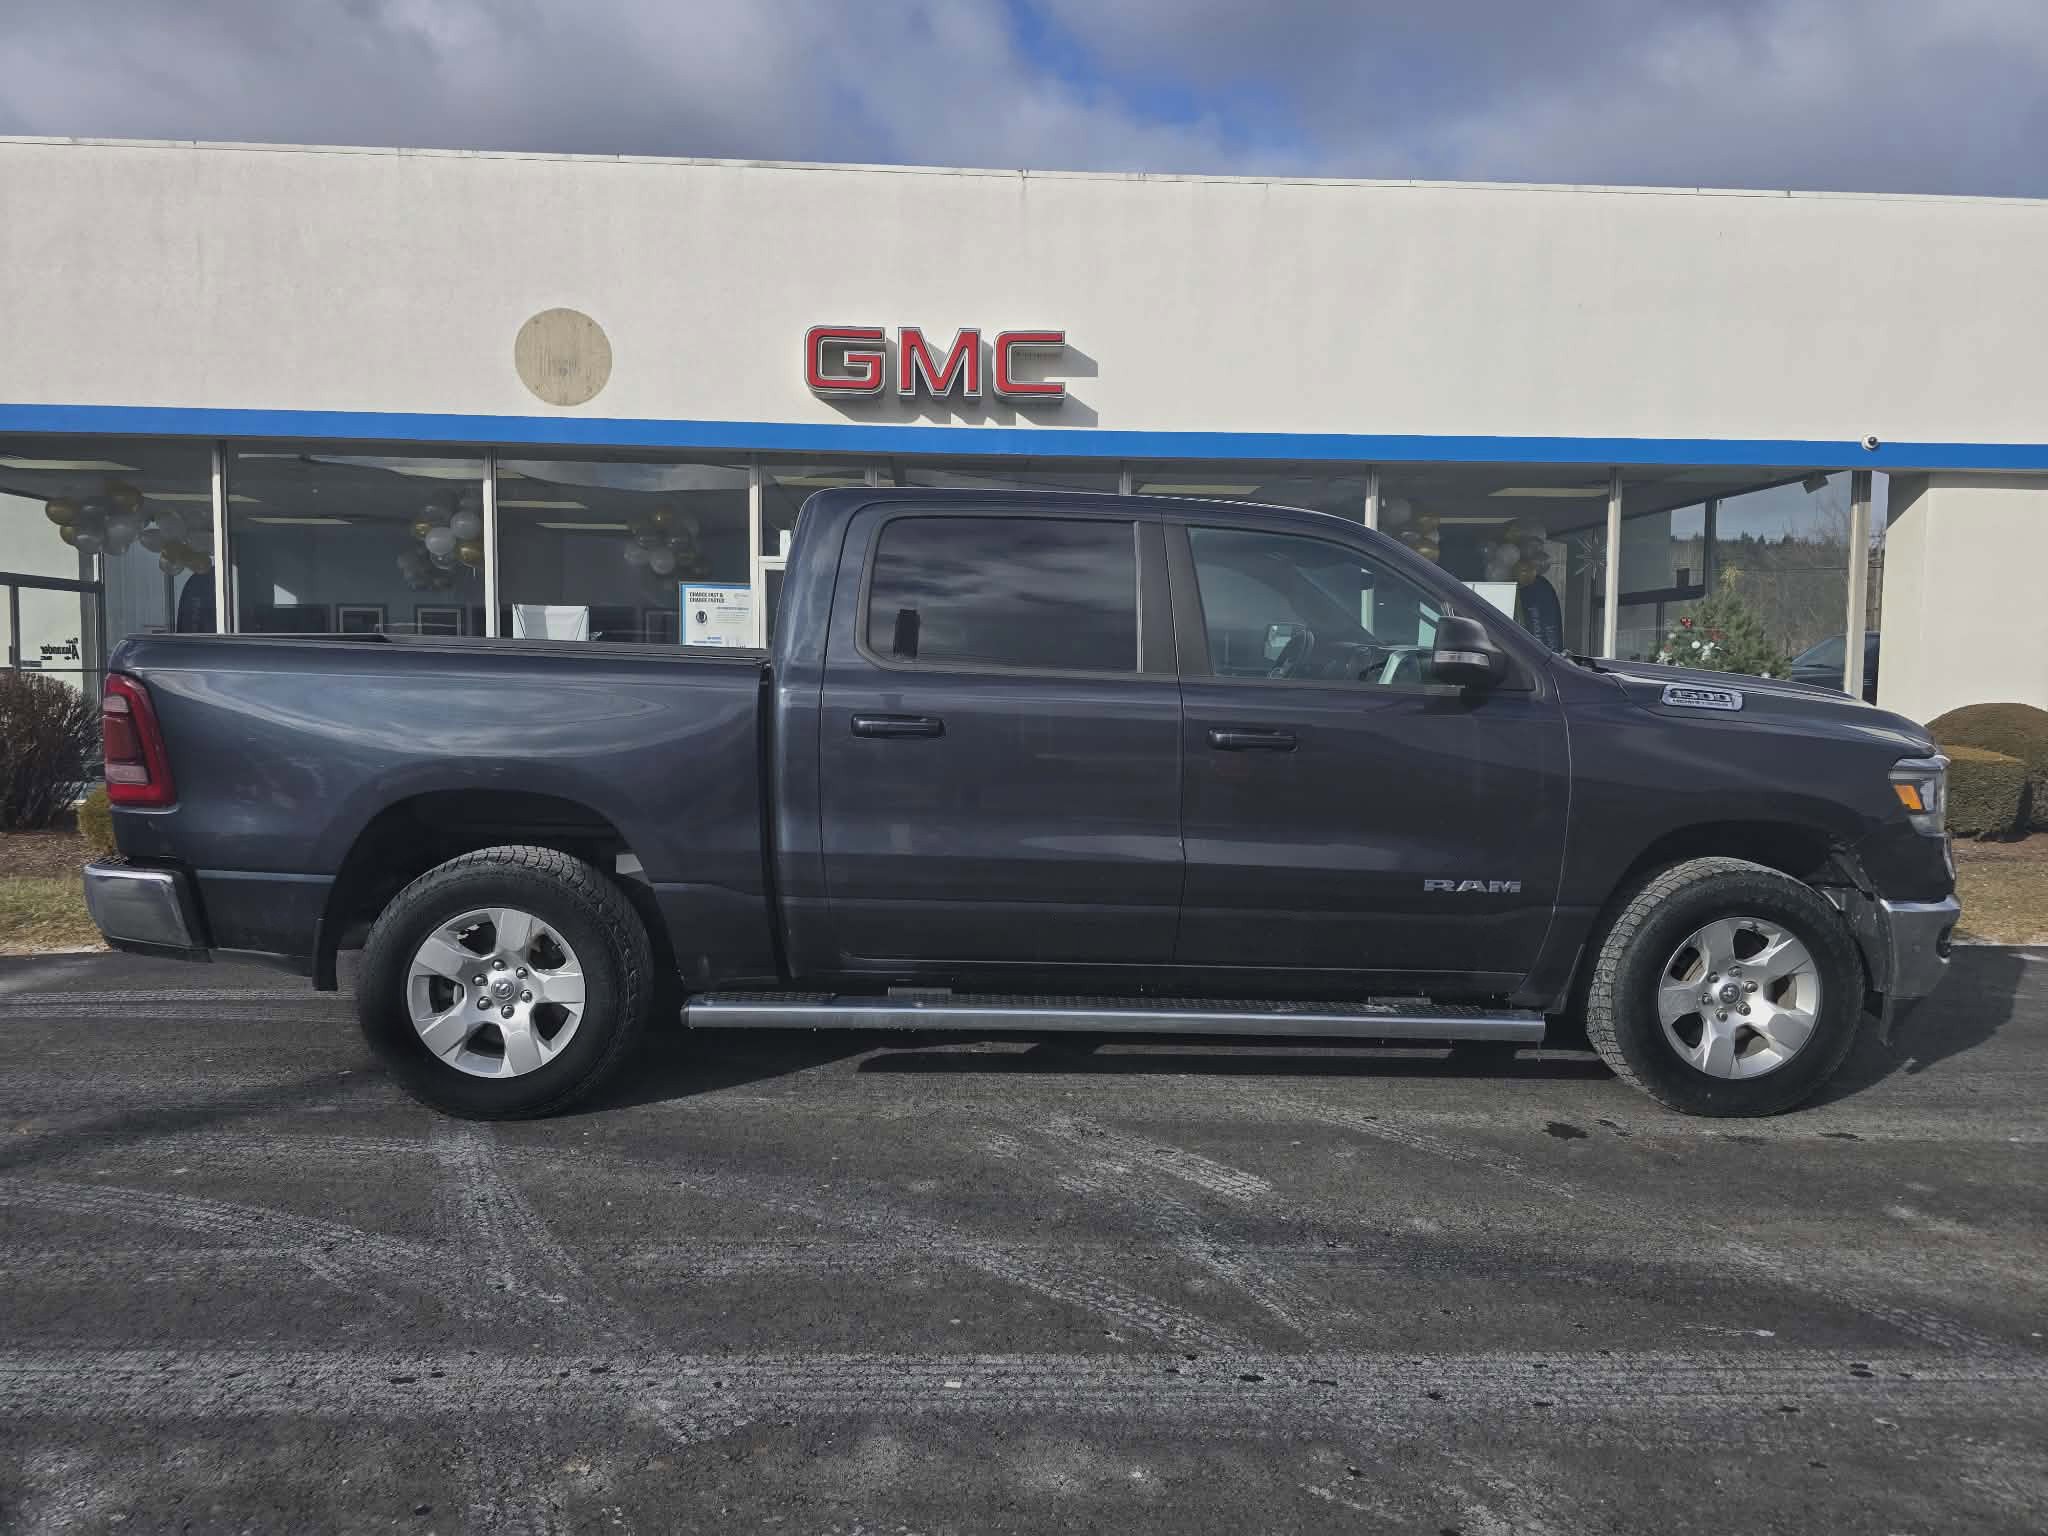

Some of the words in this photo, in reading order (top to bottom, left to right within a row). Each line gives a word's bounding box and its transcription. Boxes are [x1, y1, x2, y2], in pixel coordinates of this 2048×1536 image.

[804, 325, 1066, 398] GMC
[1670, 688, 1731, 703] 1500
[1423, 879, 1521, 893] RAM
